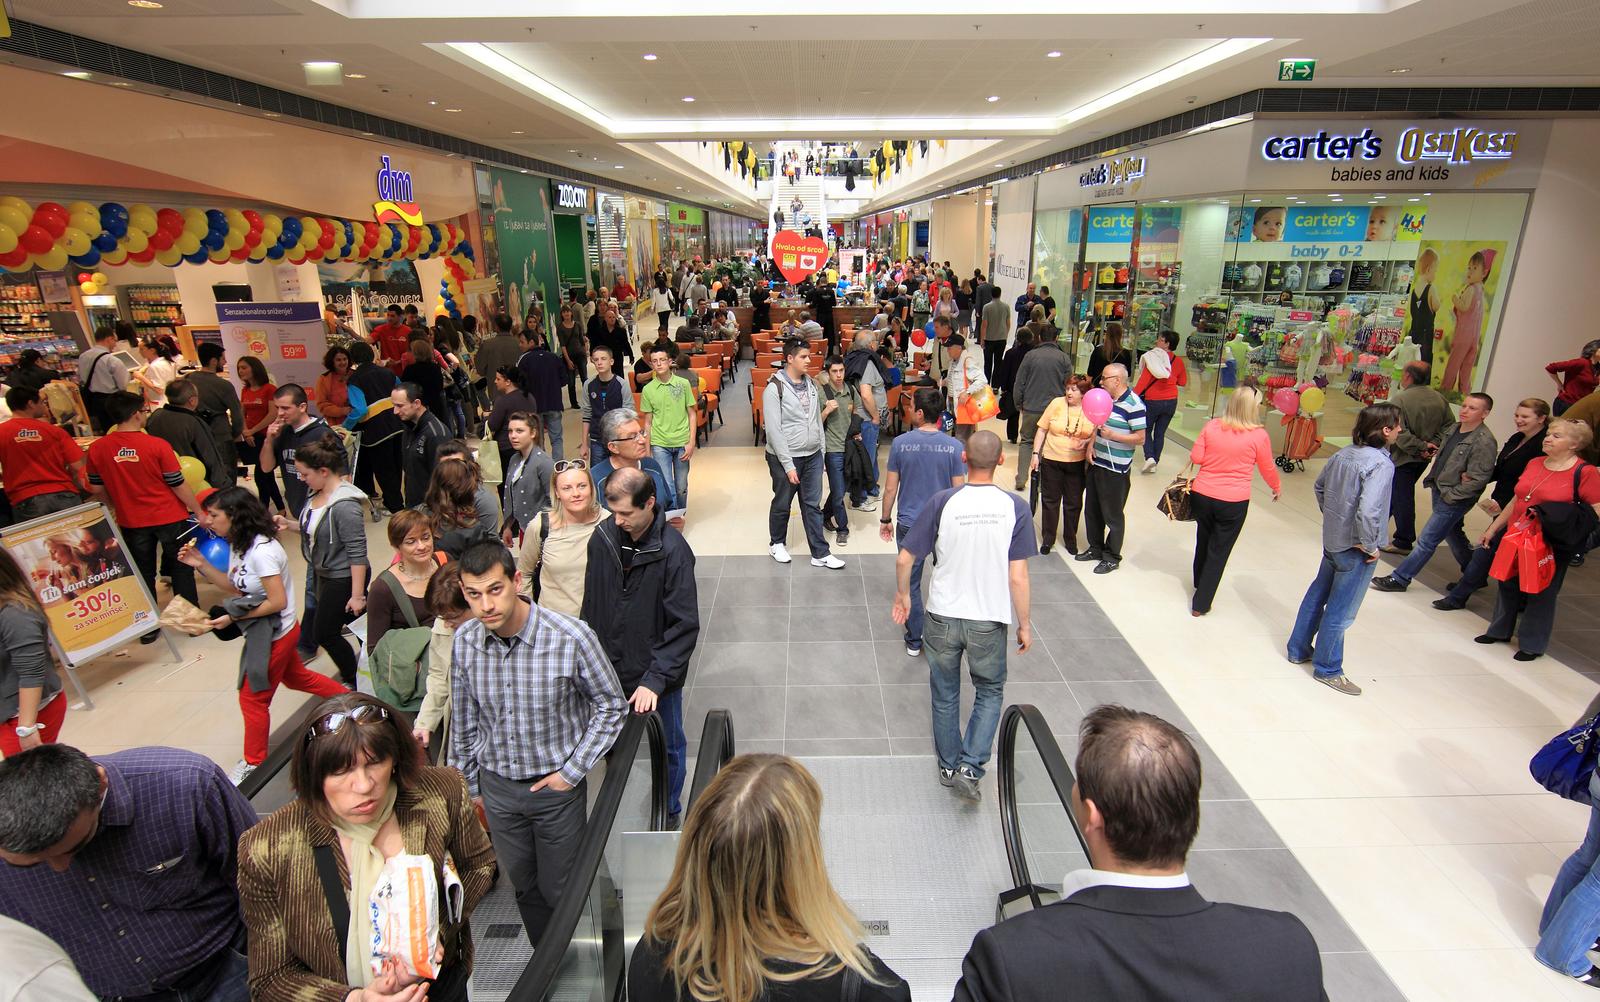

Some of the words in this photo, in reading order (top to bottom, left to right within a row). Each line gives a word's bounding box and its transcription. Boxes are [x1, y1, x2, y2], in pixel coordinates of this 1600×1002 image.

[1264, 129, 1383, 159] carter's
[379, 155, 414, 202] dm
[1331, 167, 1382, 181] babies
[1385, 166, 1415, 181] and
[1419, 165, 1449, 181] kids
[1294, 211, 1357, 227] carter's
[775, 242, 796, 251] Hvala
[796, 244, 806, 252] od
[807, 246, 825, 254] srca!
[1290, 245, 1330, 260] baby
[1339, 244, 1363, 257] 0-2
[224, 307, 267, 316] Senzacionalno
[267, 307, 293, 317] sniženje!
[18, 428, 38, 438] dm
[119, 446, 135, 457] dm
[900, 444, 920, 453] TOM
[922, 444, 955, 454] TAILOR
[62, 580, 87, 594] sam
[87, 565, 121, 585] čovjek
[66, 588, 121, 618] -30%
[134, 611, 146, 620] dm
[74, 623, 85, 631] za
[84, 616, 98, 626] sve
